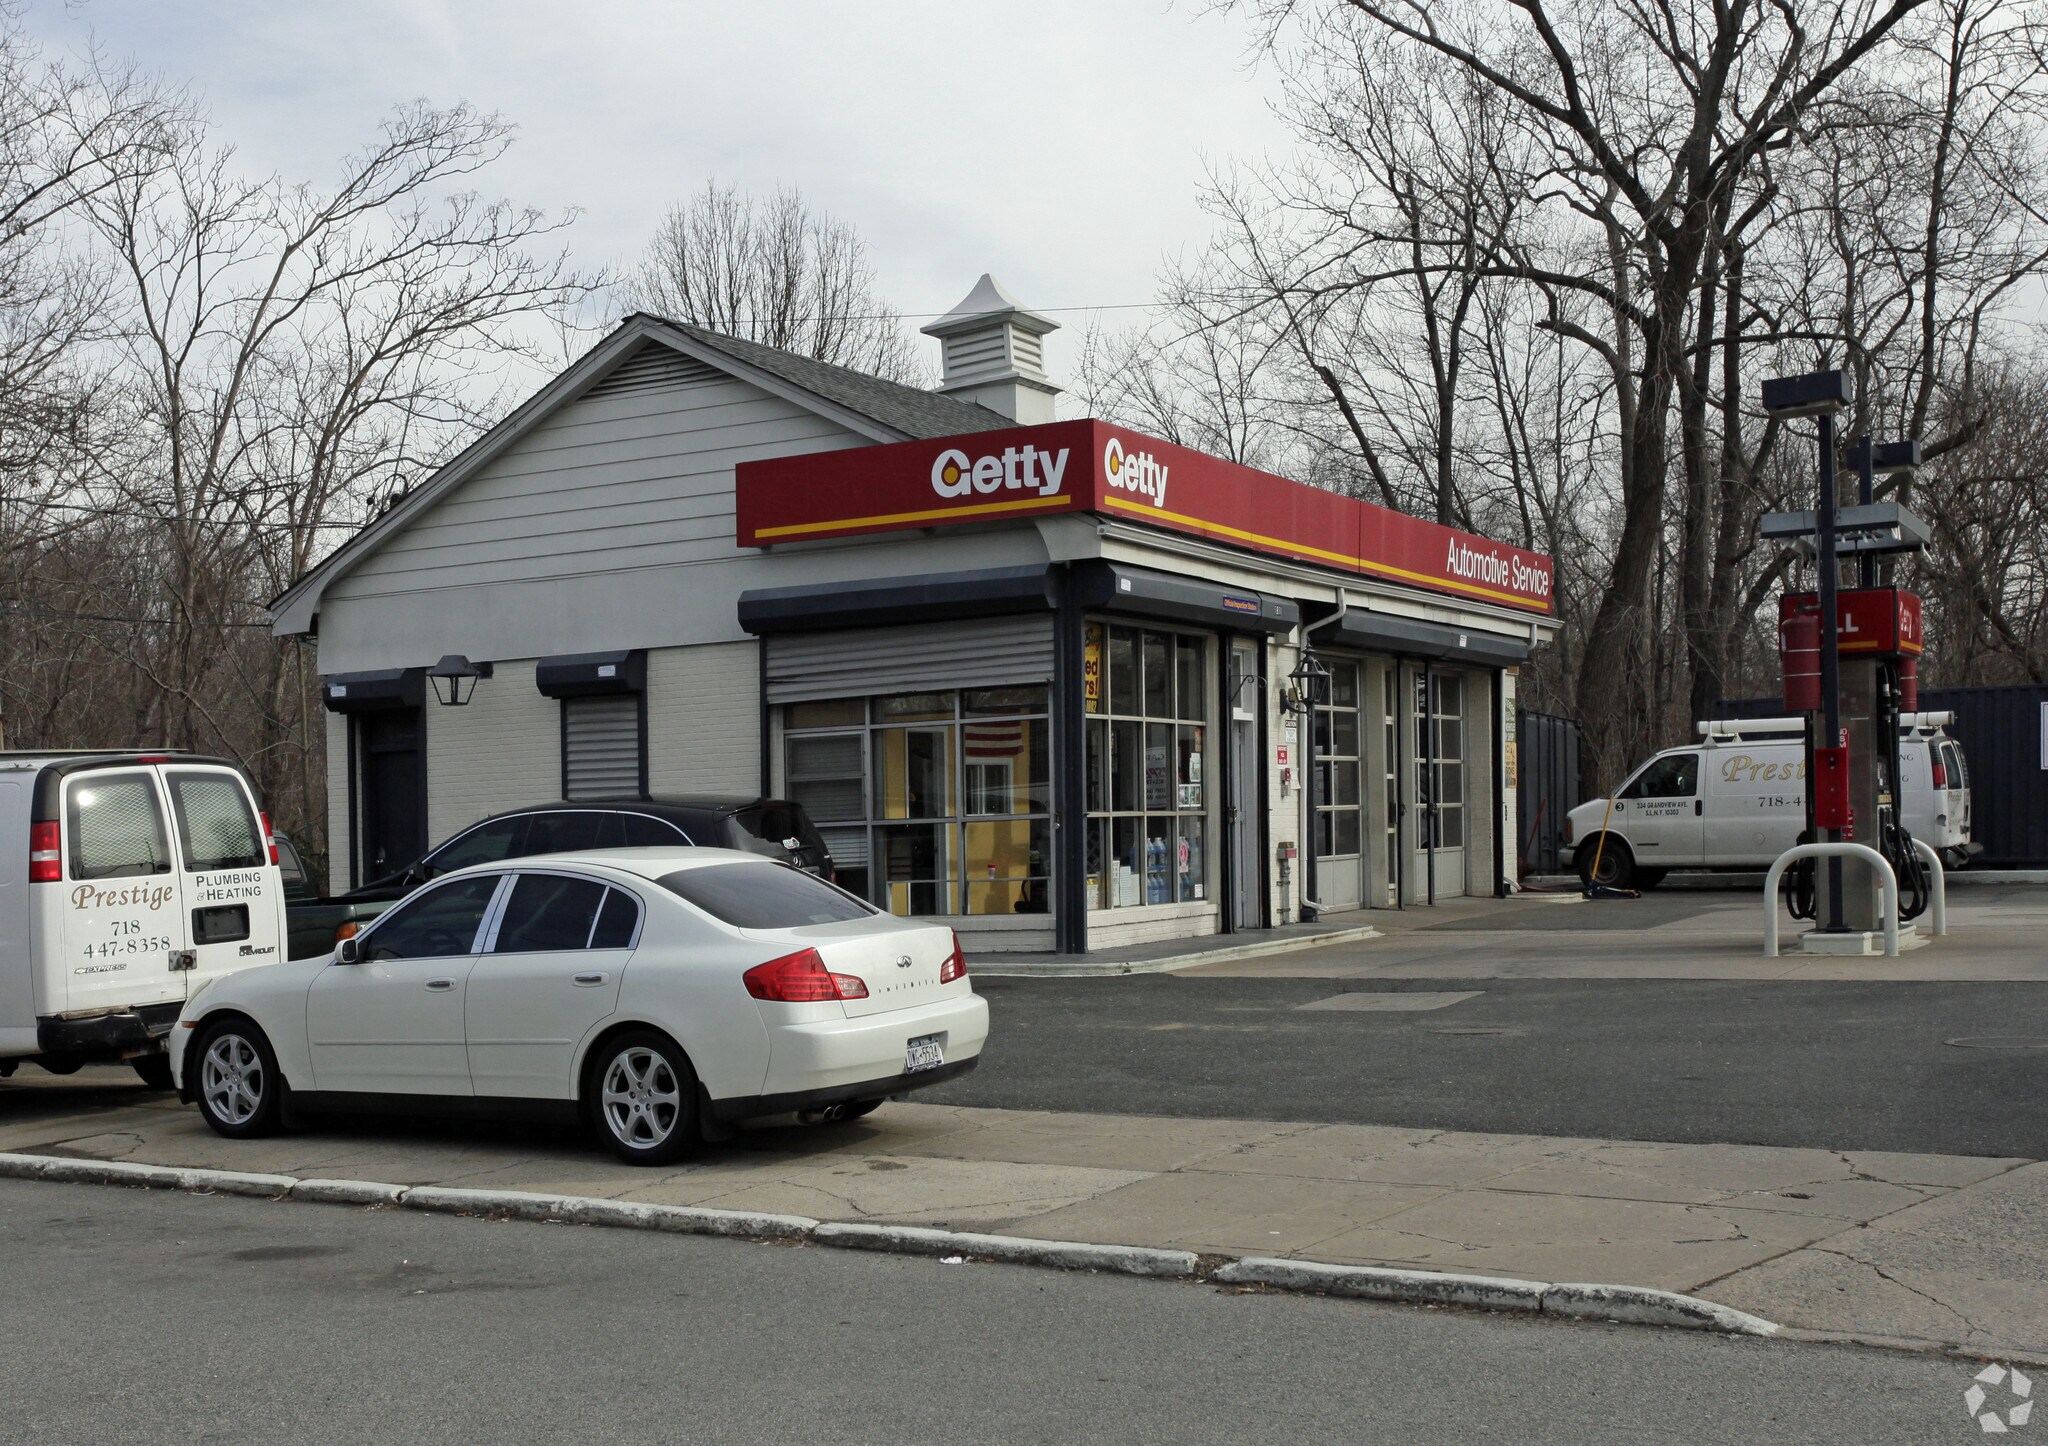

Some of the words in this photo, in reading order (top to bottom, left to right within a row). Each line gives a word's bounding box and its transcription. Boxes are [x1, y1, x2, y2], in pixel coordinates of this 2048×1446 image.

[931, 445, 1070, 498] Getty
[1104, 438, 1168, 507] Getty
[1446, 537, 1509, 587] Automotive
[1512, 555, 1548, 596] Service
[1085, 657, 1098, 677] ed
[1722, 755, 1805, 782] Prest
[196, 872, 261, 887] PLUMBING
[71, 881, 173, 911] Prestige
[207, 886, 262, 900] HEATING
[111, 920, 141, 936] 718
[83, 936, 171, 959] 447-8358
[239, 946, 275, 956] CHEVROLET
